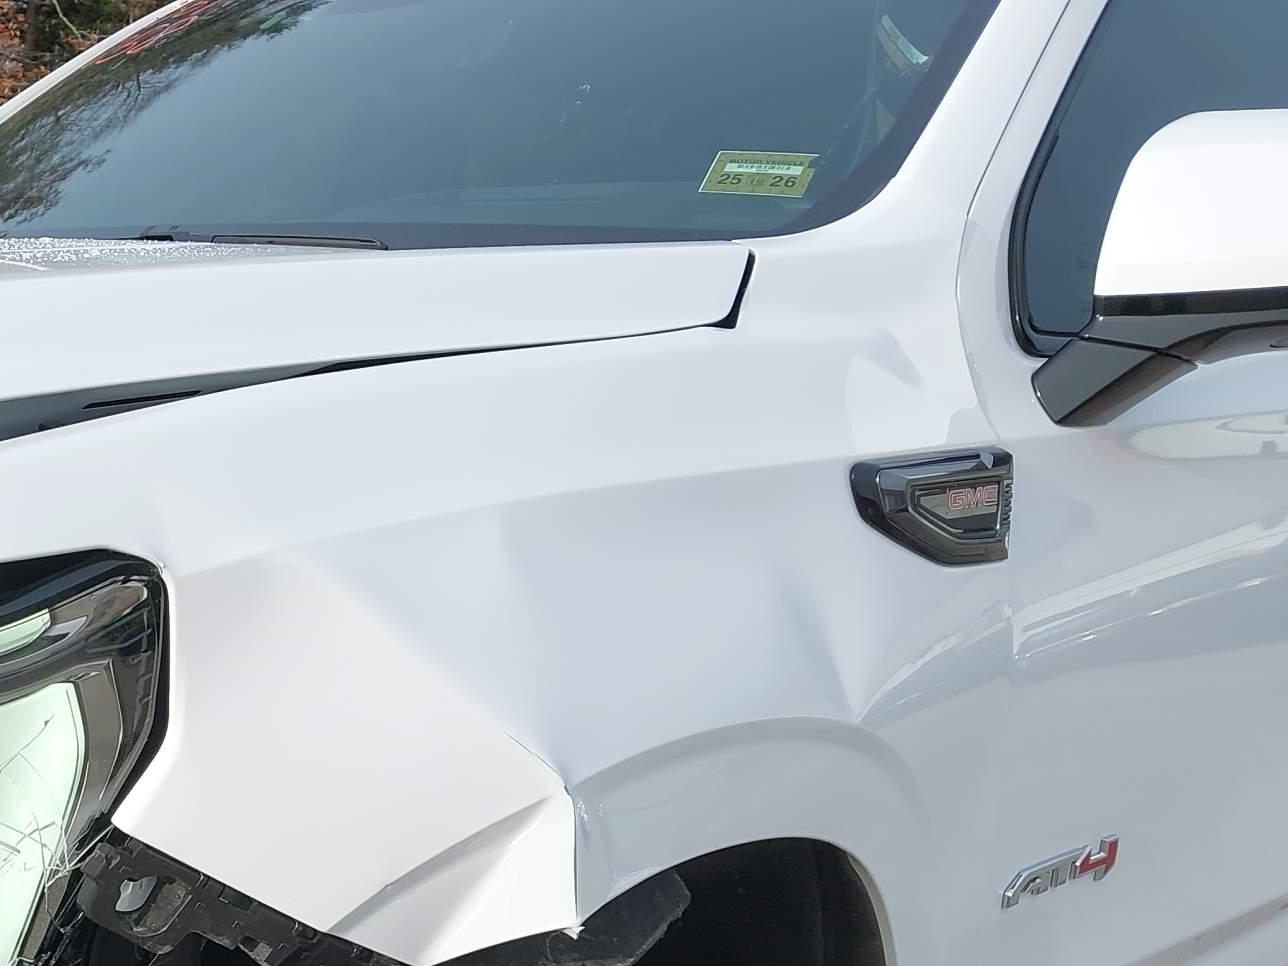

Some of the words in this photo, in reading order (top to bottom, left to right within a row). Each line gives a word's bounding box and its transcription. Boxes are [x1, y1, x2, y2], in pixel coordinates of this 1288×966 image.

[717, 173, 744, 185] 25
[769, 175, 798, 188] 26
[948, 485, 999, 511] GMC
[1000, 833, 1120, 910] AT4
